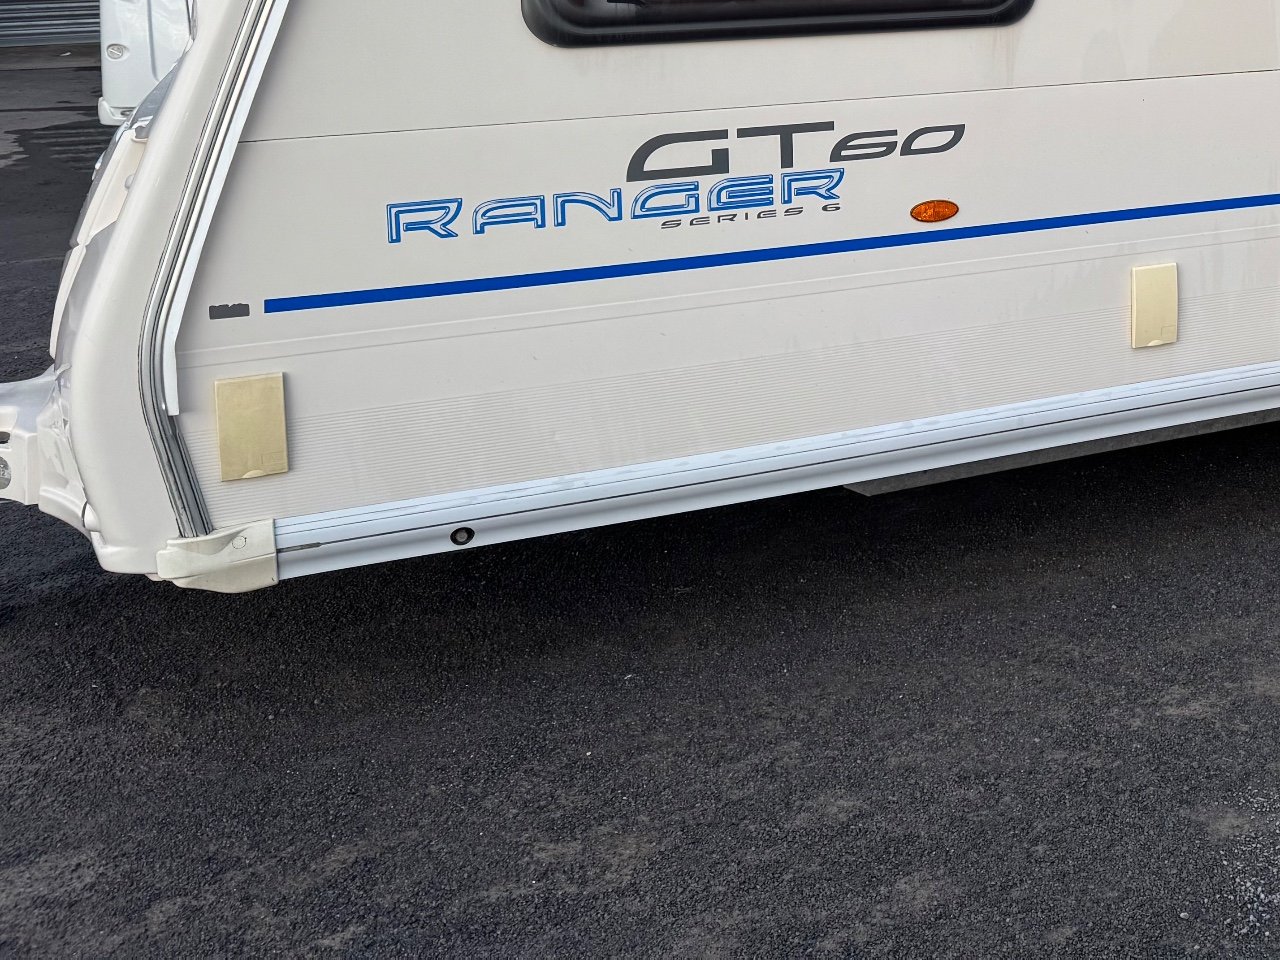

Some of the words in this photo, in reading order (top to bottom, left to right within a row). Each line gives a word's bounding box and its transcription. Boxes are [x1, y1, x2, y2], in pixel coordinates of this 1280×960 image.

[386, 168, 845, 244] RANGER
[661, 206, 804, 230] SERIES
[821, 202, 841, 213] 6
